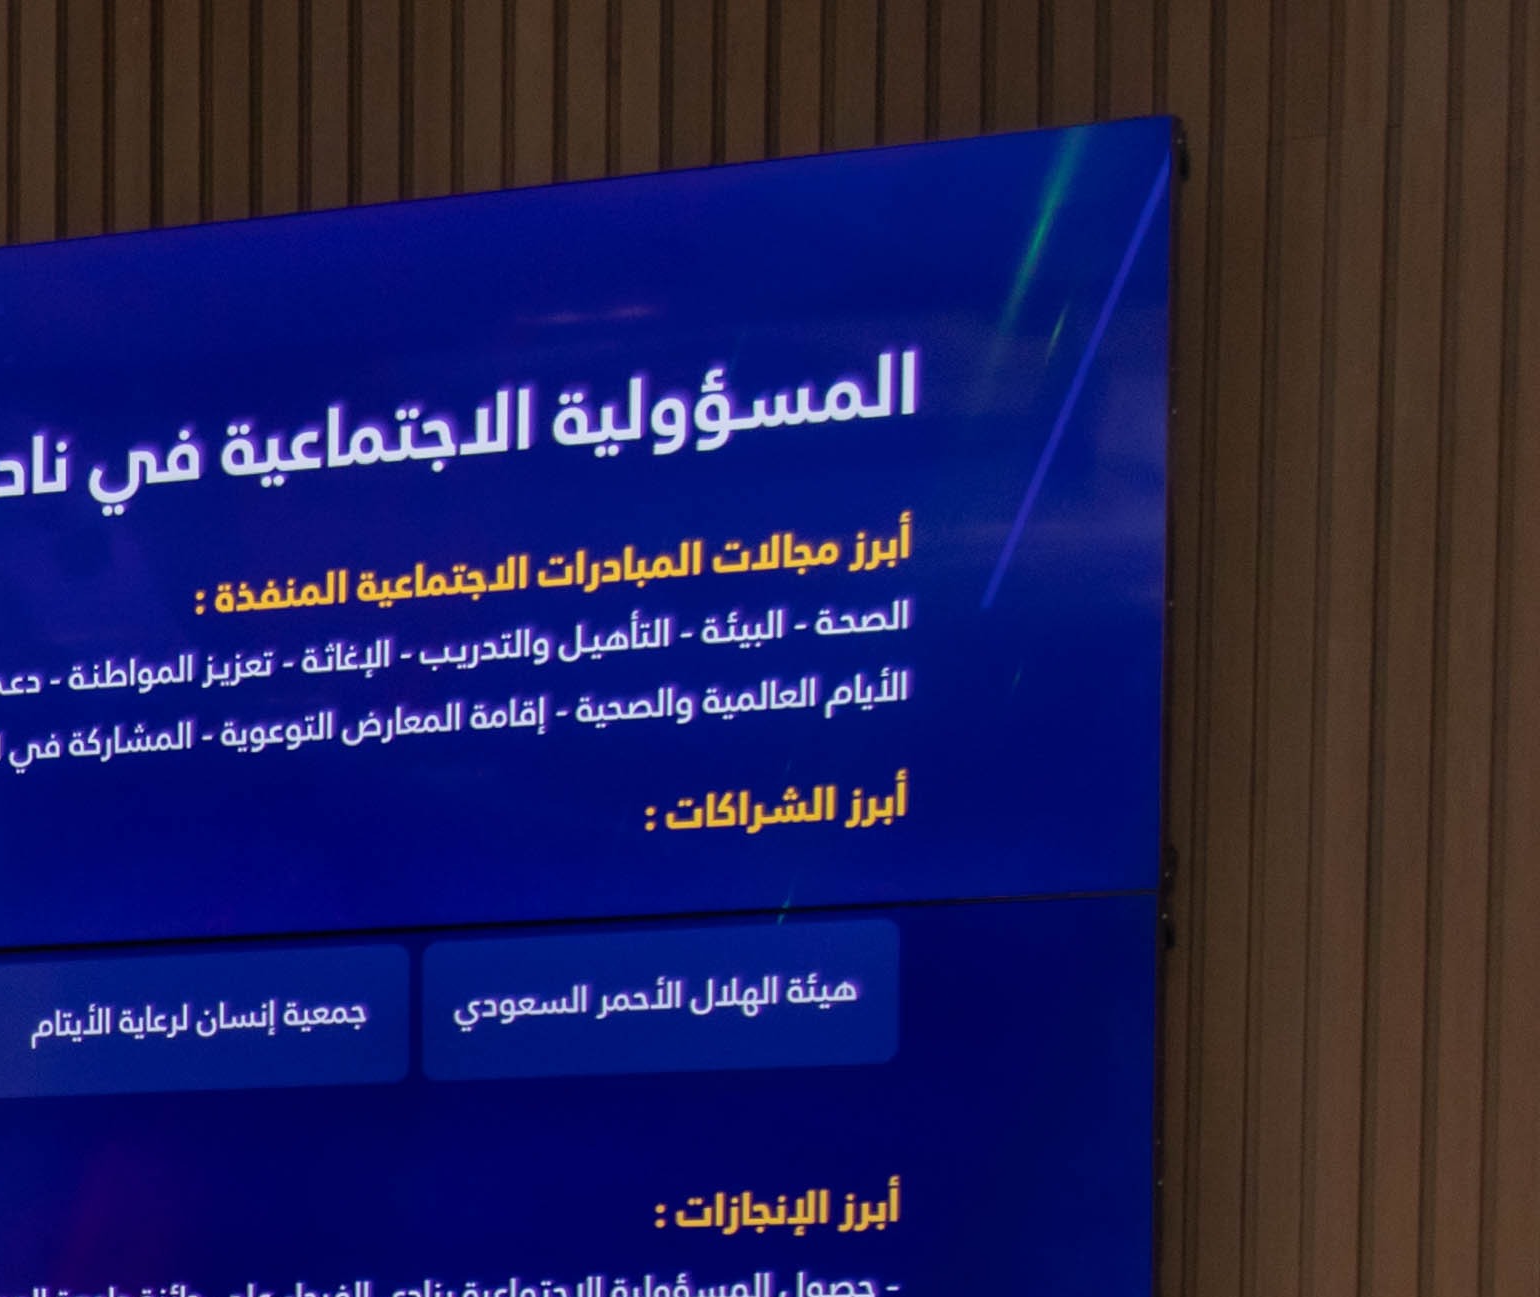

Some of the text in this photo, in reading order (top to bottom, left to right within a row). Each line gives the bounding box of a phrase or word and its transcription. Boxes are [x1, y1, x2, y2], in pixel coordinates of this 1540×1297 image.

[552, 350, 916, 458] المسؤولية
[220, 387, 531, 488] الاجتماعية
[88, 429, 201, 517] في
[712, 532, 840, 576] مجالات
[848, 509, 911, 572] أبرز
[356, 554, 528, 609] الاجتماعية
[537, 539, 702, 593] المبادرات
[214, 569, 347, 613] المنفذة
[557, 610, 670, 663] التأهيل
[700, 609, 783, 649] البيئة
[814, 600, 909, 636] الصحة
[201, 651, 274, 689] تعزيز
[301, 638, 390, 679] الإغاثة
[418, 628, 550, 672] والتدريب
[67, 653, 194, 694] المواطنة
[824, 666, 908, 719] الأيام
[469, 695, 546, 735] إقامة
[575, 686, 693, 729] والصحية
[701, 676, 816, 721] العالمية
[68, 720, 192, 763] المشاركة
[219, 710, 333, 753] التوعوية
[341, 701, 461, 747] المعارض
[8, 733, 61, 774] في
[665, 785, 836, 834] الشراكات
[844, 768, 906, 829] أبرز
[453, 973, 857, 1027] هيئة الهلال الأحمر السعودي
[30, 999, 367, 1050] جمعية إنسان لرعاية الأيتام
[675, 1188, 829, 1237] الإنجازات
[837, 1175, 900, 1233] أبرز
